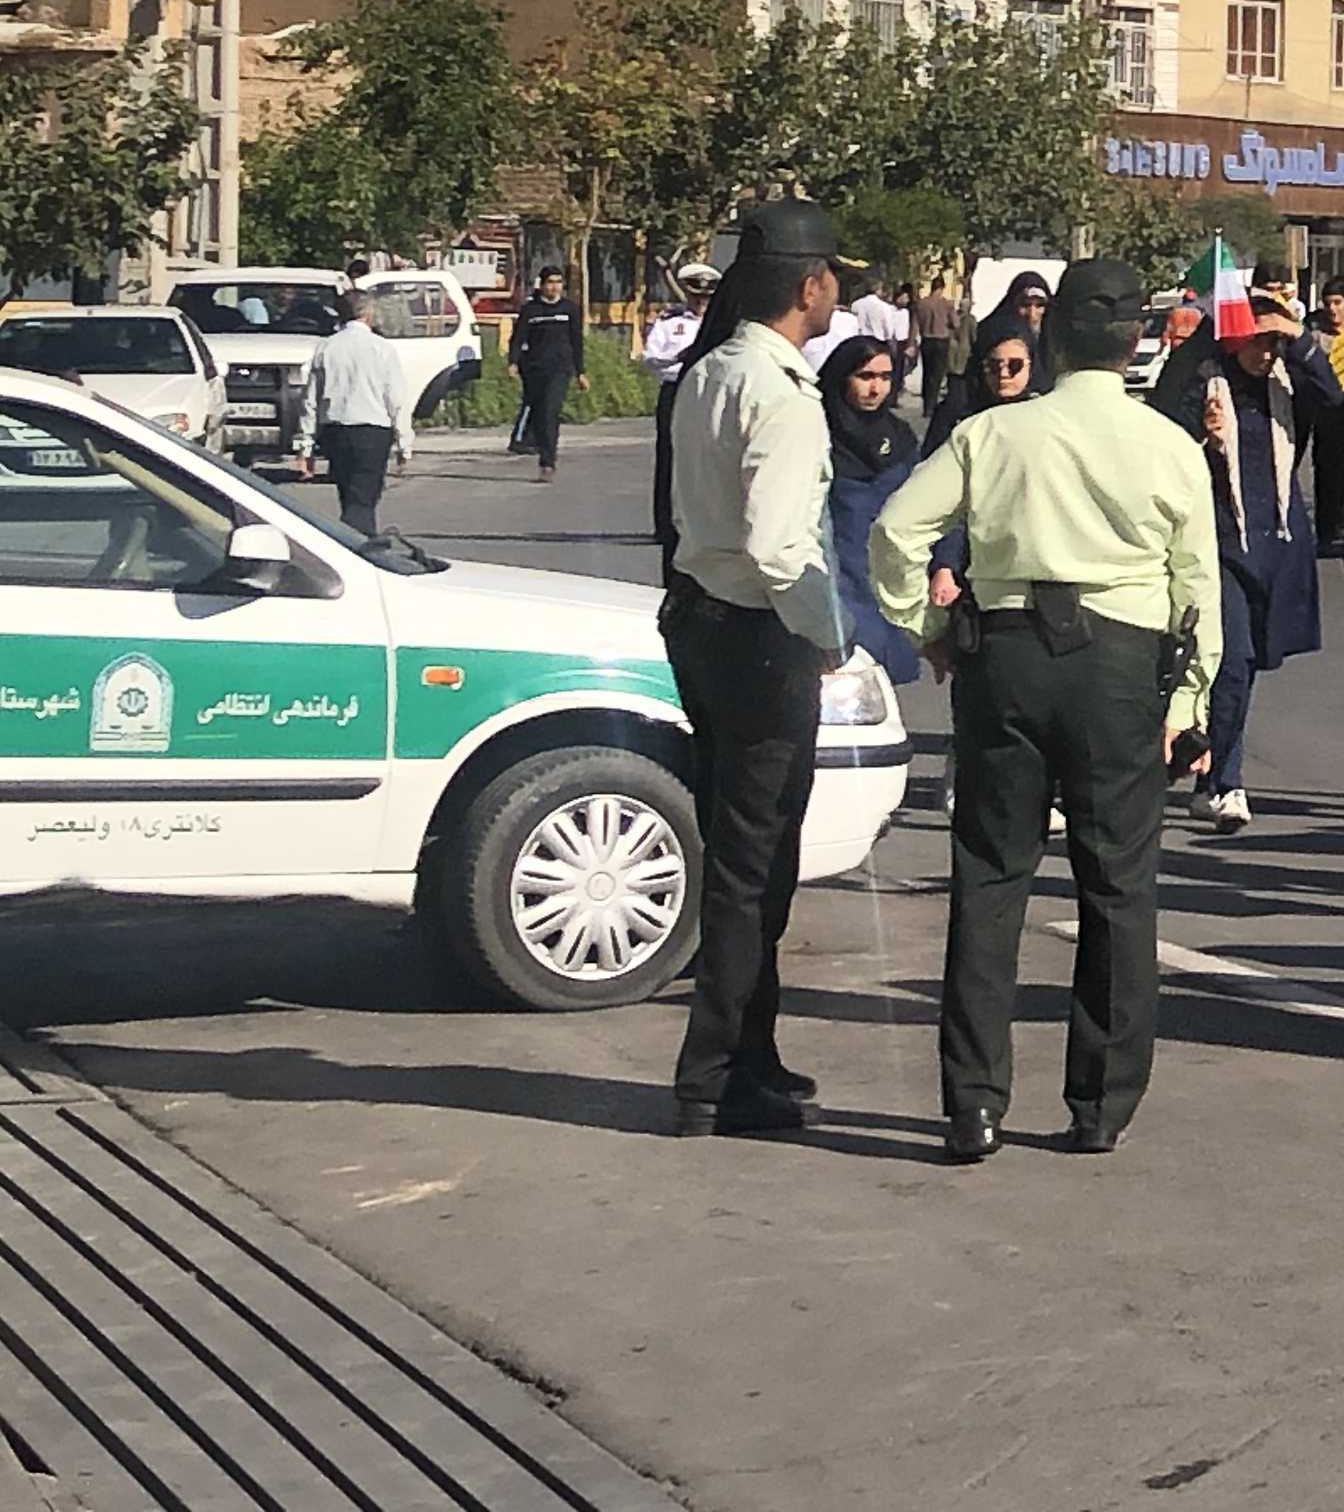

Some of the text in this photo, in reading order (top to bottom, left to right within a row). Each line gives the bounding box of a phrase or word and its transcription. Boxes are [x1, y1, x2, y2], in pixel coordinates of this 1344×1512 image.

[0, 685, 359, 728] فرماندهی انتظامی شهرستا
